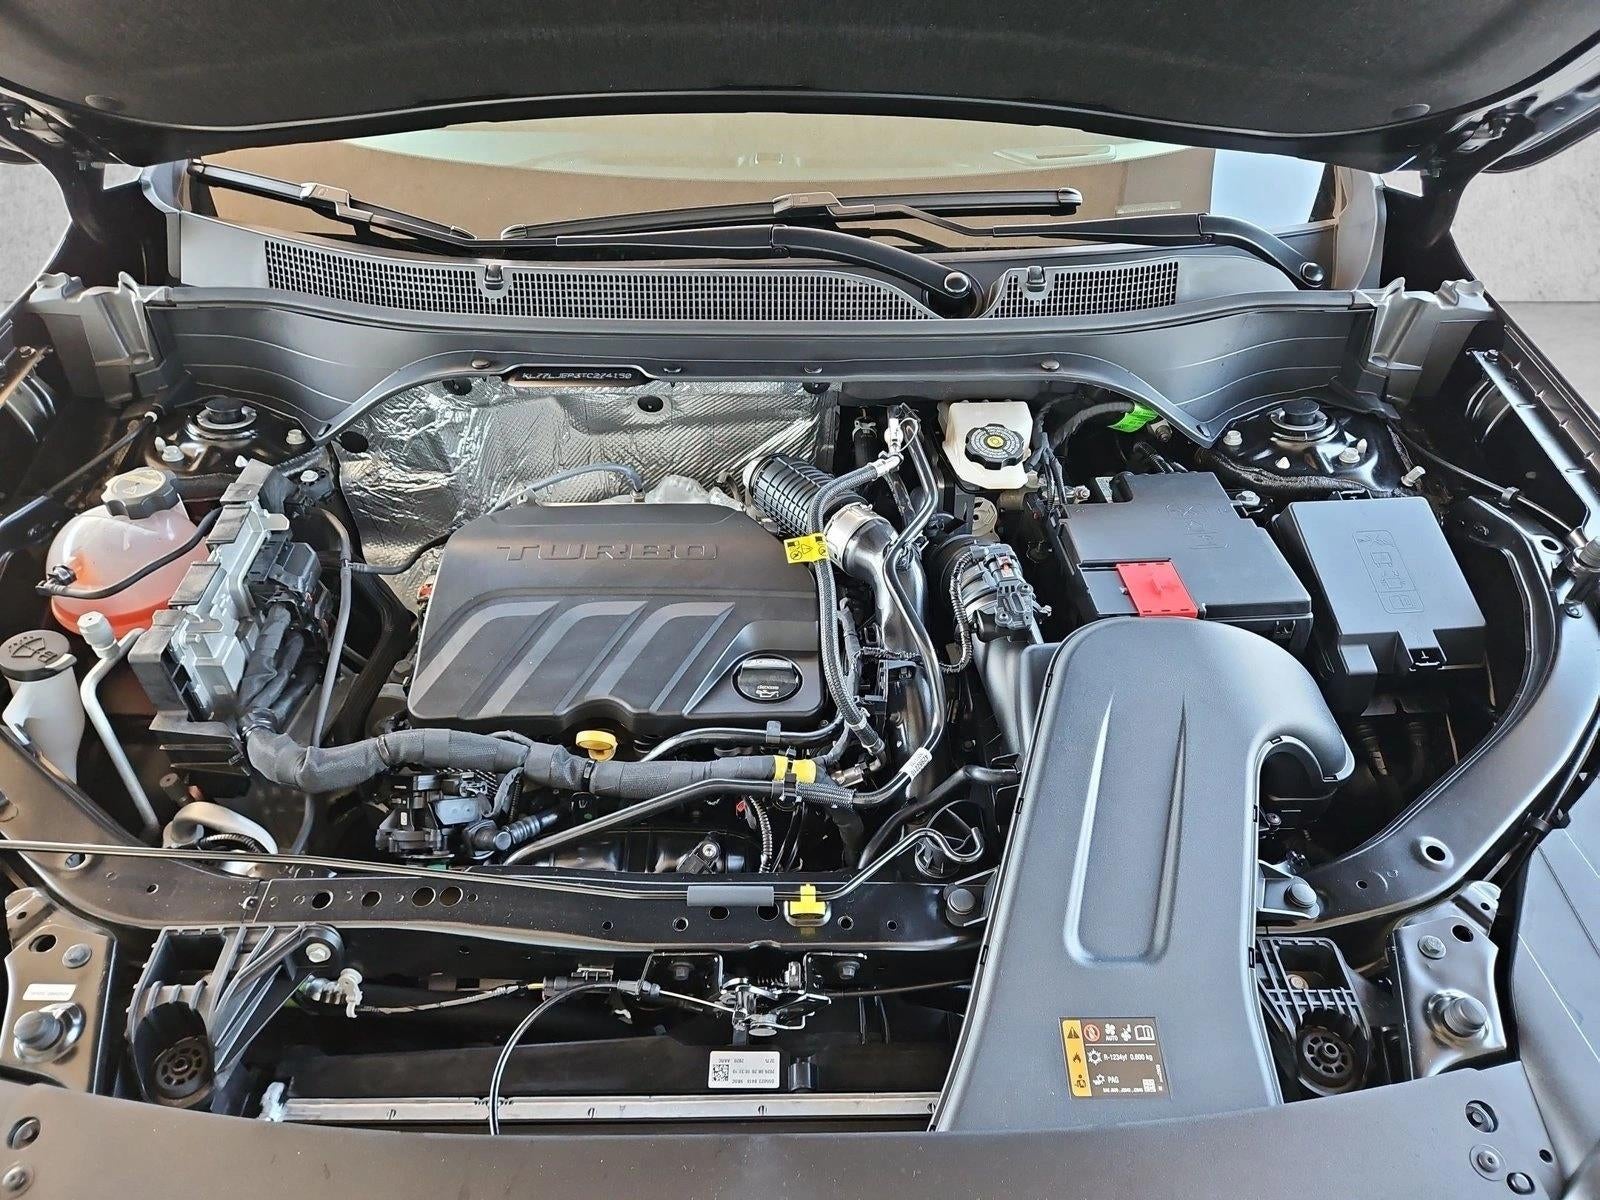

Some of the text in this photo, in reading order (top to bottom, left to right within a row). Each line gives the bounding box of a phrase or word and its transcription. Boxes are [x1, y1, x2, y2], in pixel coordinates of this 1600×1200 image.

[497, 543, 719, 560] TURBO
[1103, 1053, 1128, 1062] R-1234yf
[1145, 1053, 1153, 1062] kg
[1107, 1076, 1119, 1084] PAG
